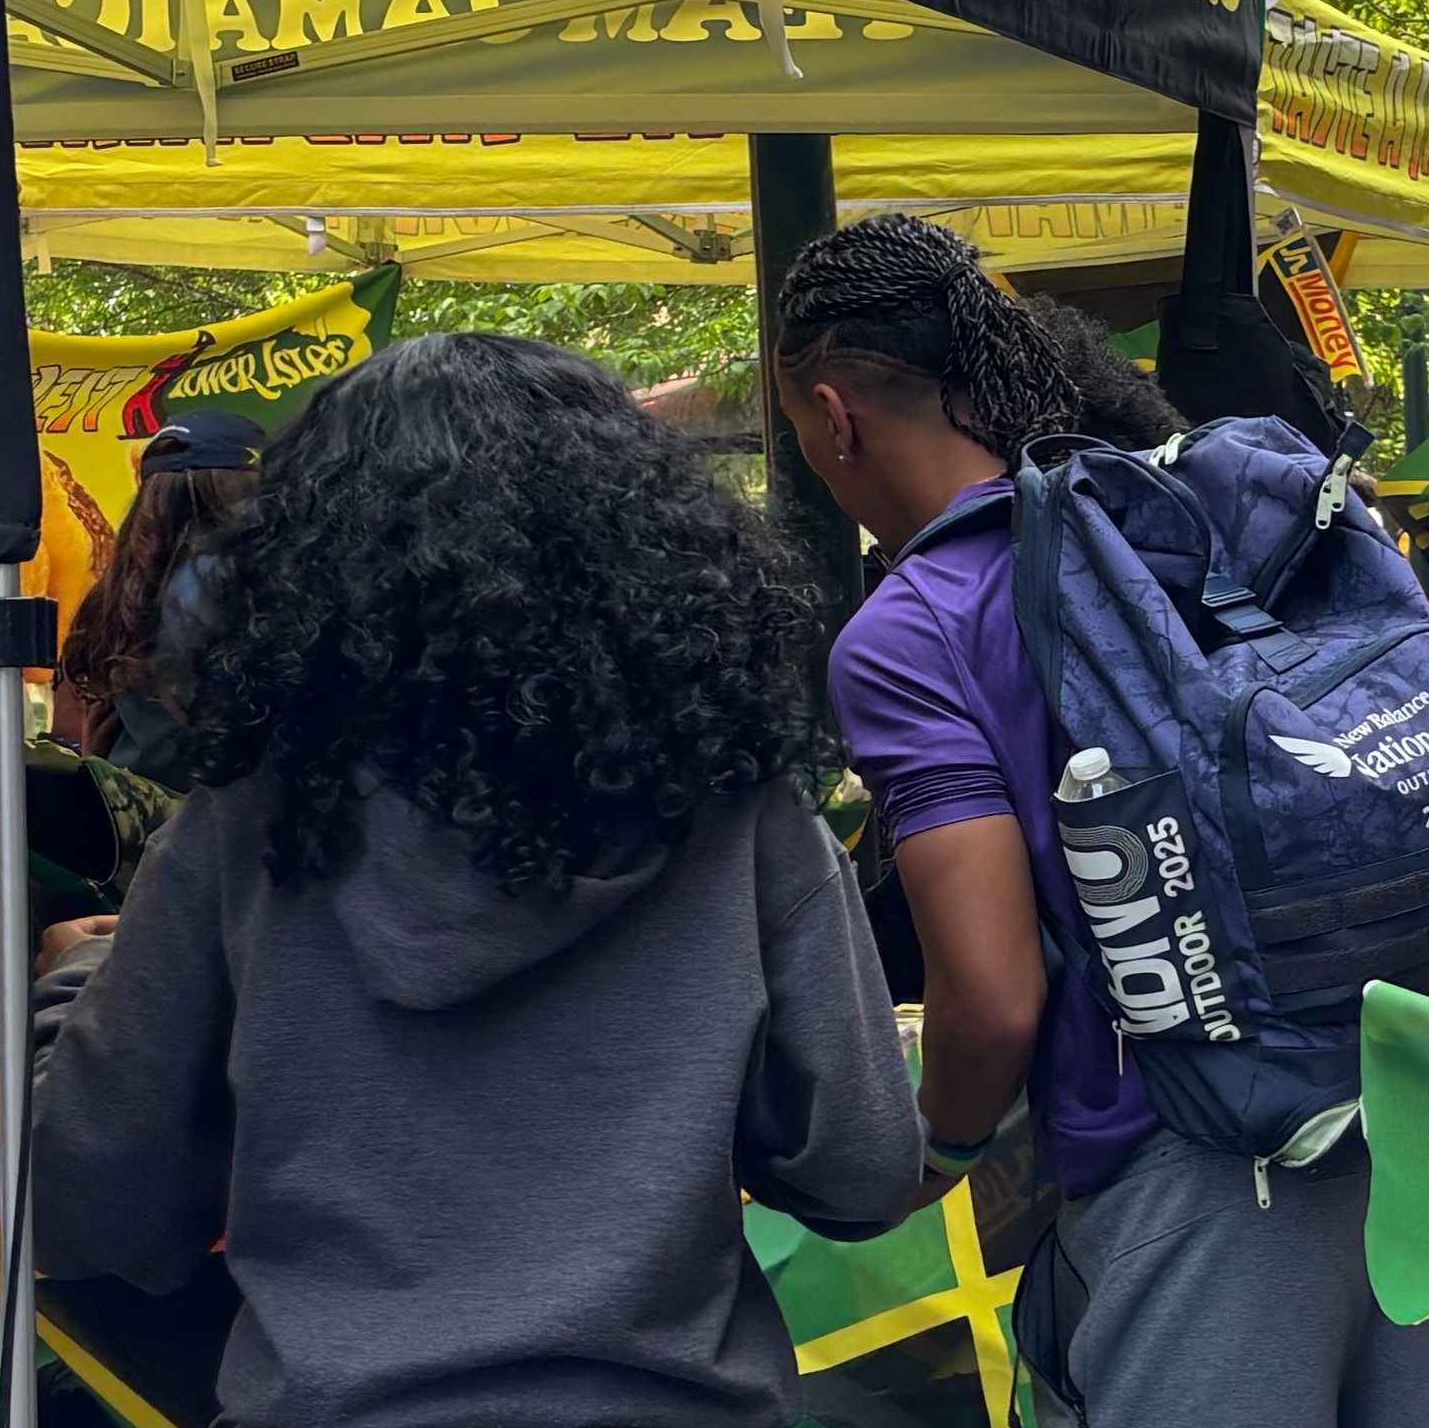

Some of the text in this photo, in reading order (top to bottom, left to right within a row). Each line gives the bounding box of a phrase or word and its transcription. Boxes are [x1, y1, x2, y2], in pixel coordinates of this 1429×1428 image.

[1295, 272, 1358, 369] Money
[1333, 718, 1375, 751] New
[1146, 815, 1242, 1043] OUTDOOR 2025
